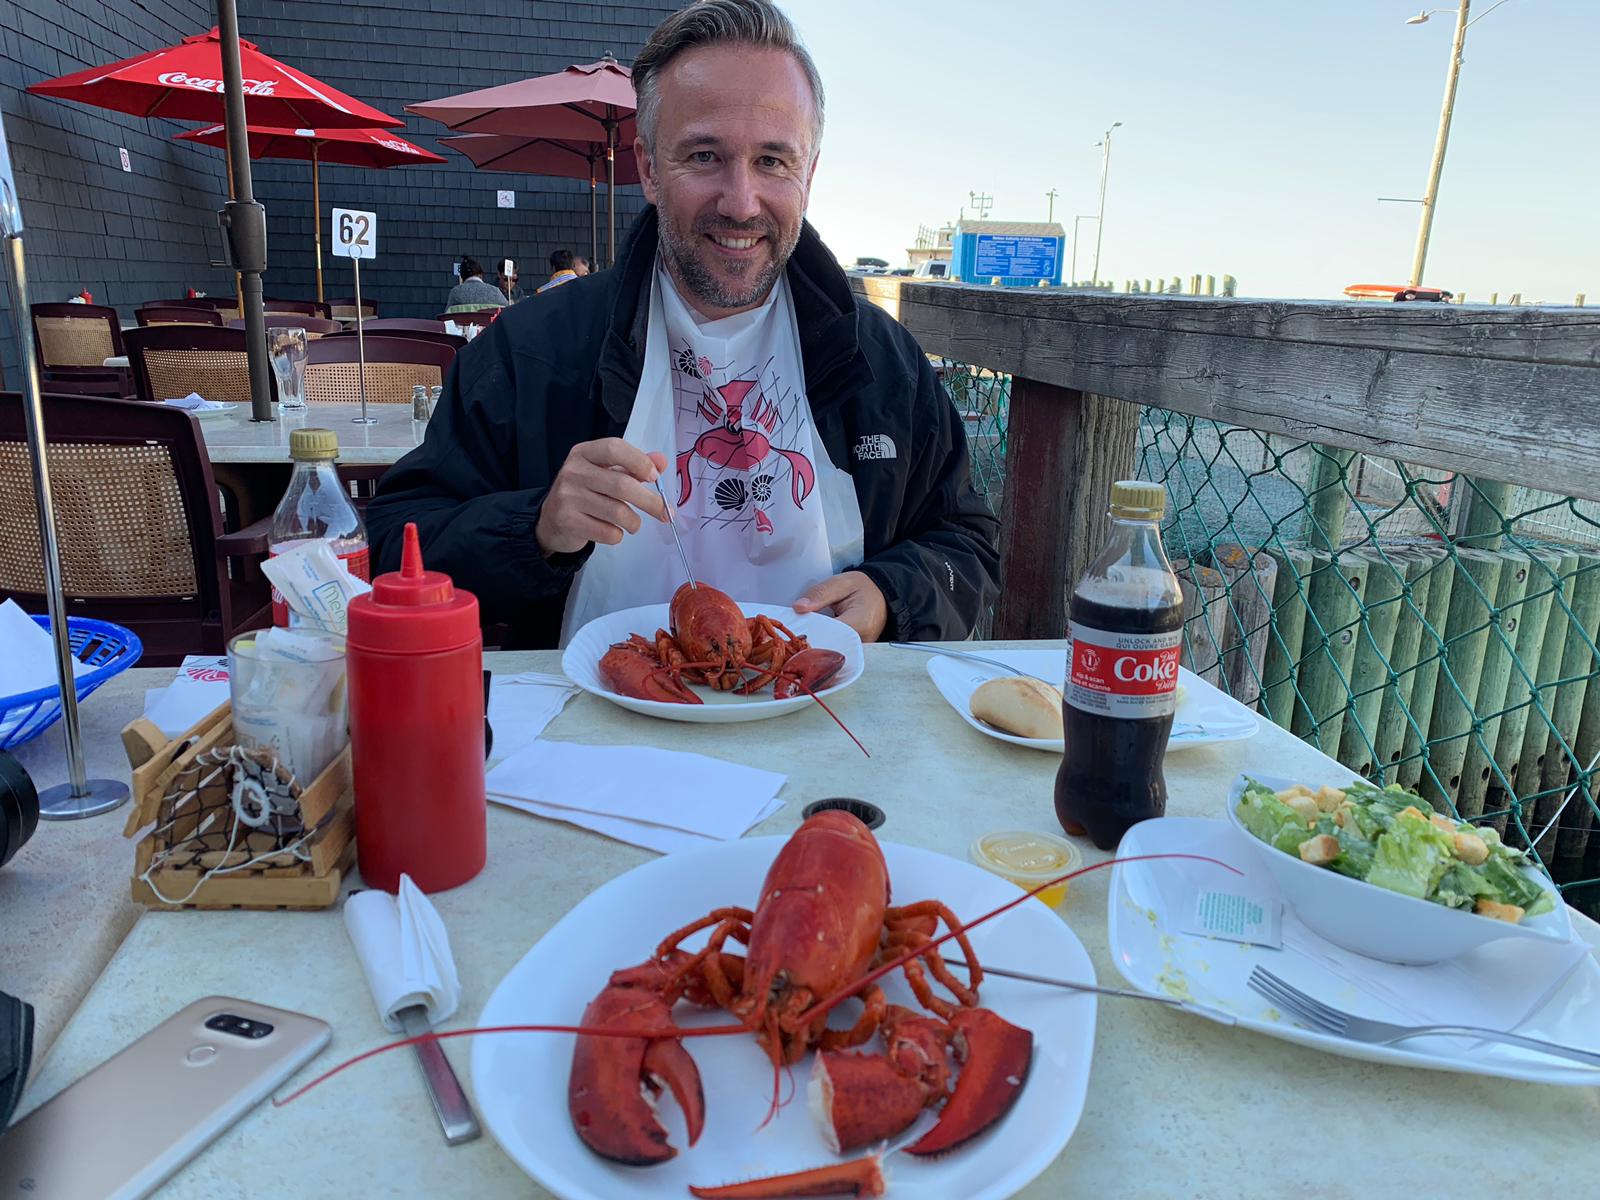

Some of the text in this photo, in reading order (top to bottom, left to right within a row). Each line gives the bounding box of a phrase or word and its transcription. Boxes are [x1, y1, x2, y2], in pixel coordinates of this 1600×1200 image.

[340, 213, 369, 245] 62
[860, 435, 880, 444] THE
[858, 451, 880, 461] FACE
[1113, 656, 1176, 682] Coke
